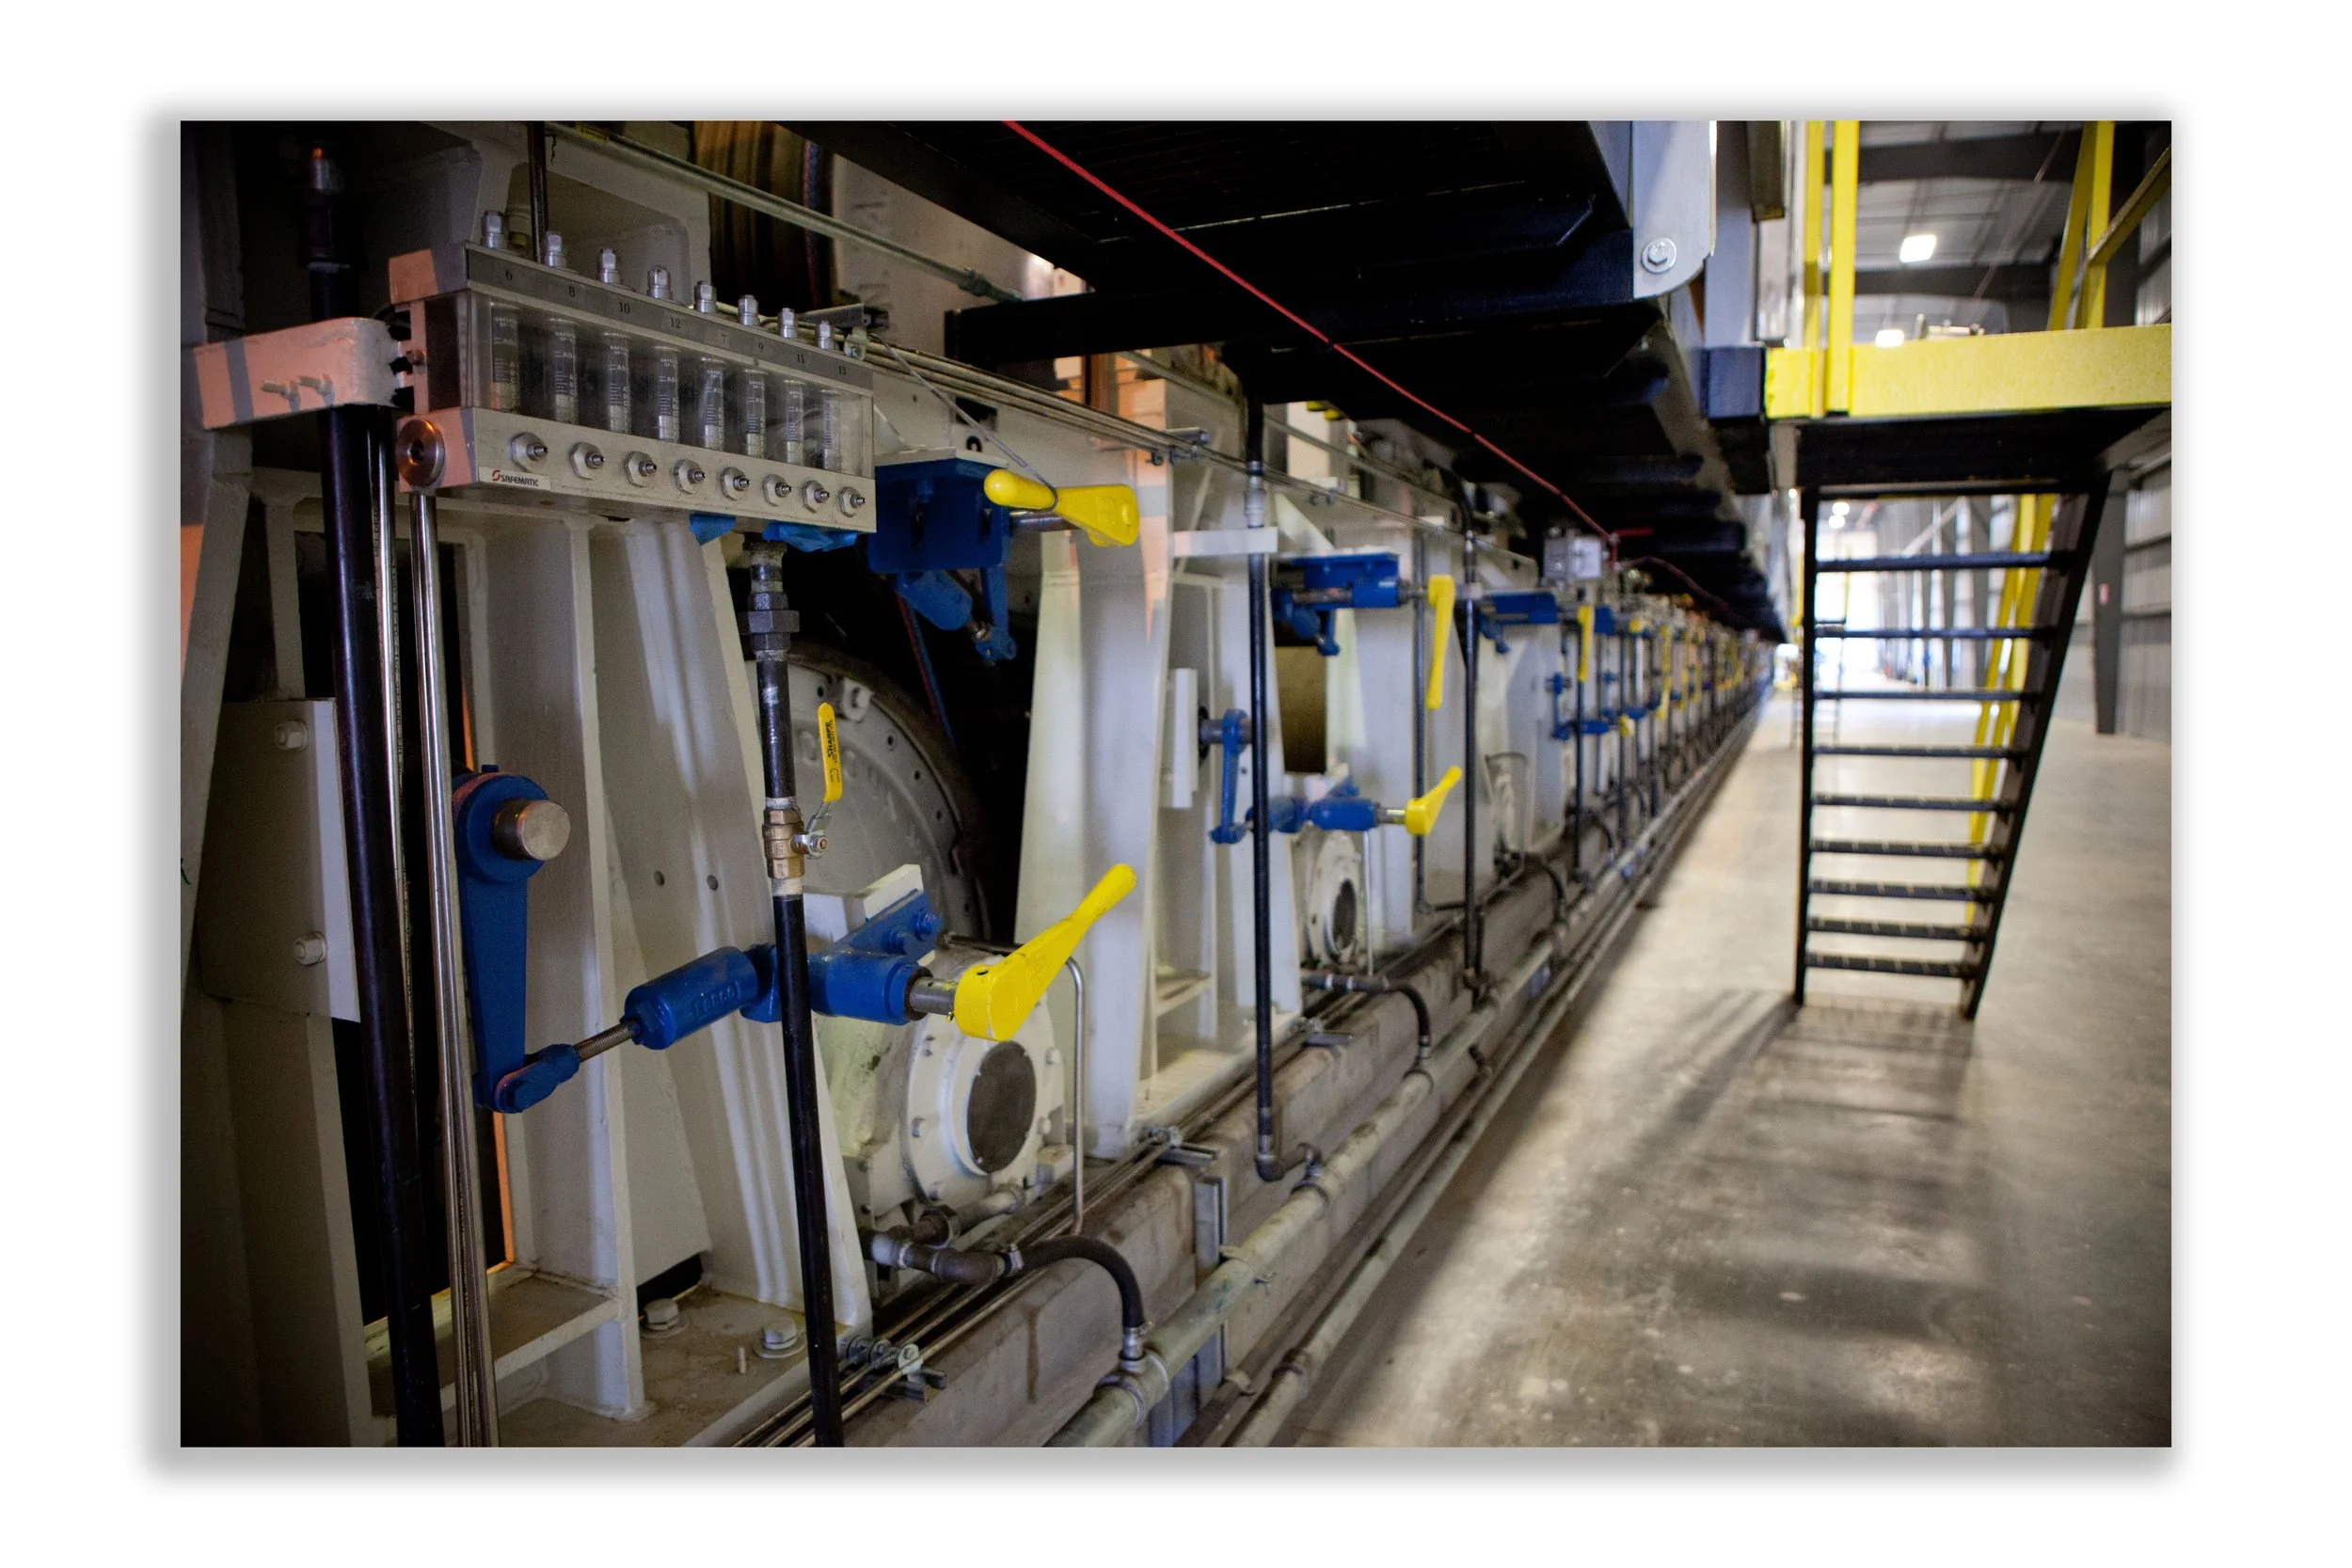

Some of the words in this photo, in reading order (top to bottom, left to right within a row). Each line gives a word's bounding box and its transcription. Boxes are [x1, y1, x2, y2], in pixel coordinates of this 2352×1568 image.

[505, 270, 513, 281] 6
[568, 286, 576, 297] 8
[618, 302, 630, 314] 10
[669, 316, 682, 329] 12
[721, 334, 727, 343] 7
[758, 342, 764, 352] 9
[797, 354, 805, 363] 11
[838, 366, 847, 375] 13
[501, 475, 539, 486] SAFEMATIC
[825, 721, 835, 760] SHARPE
